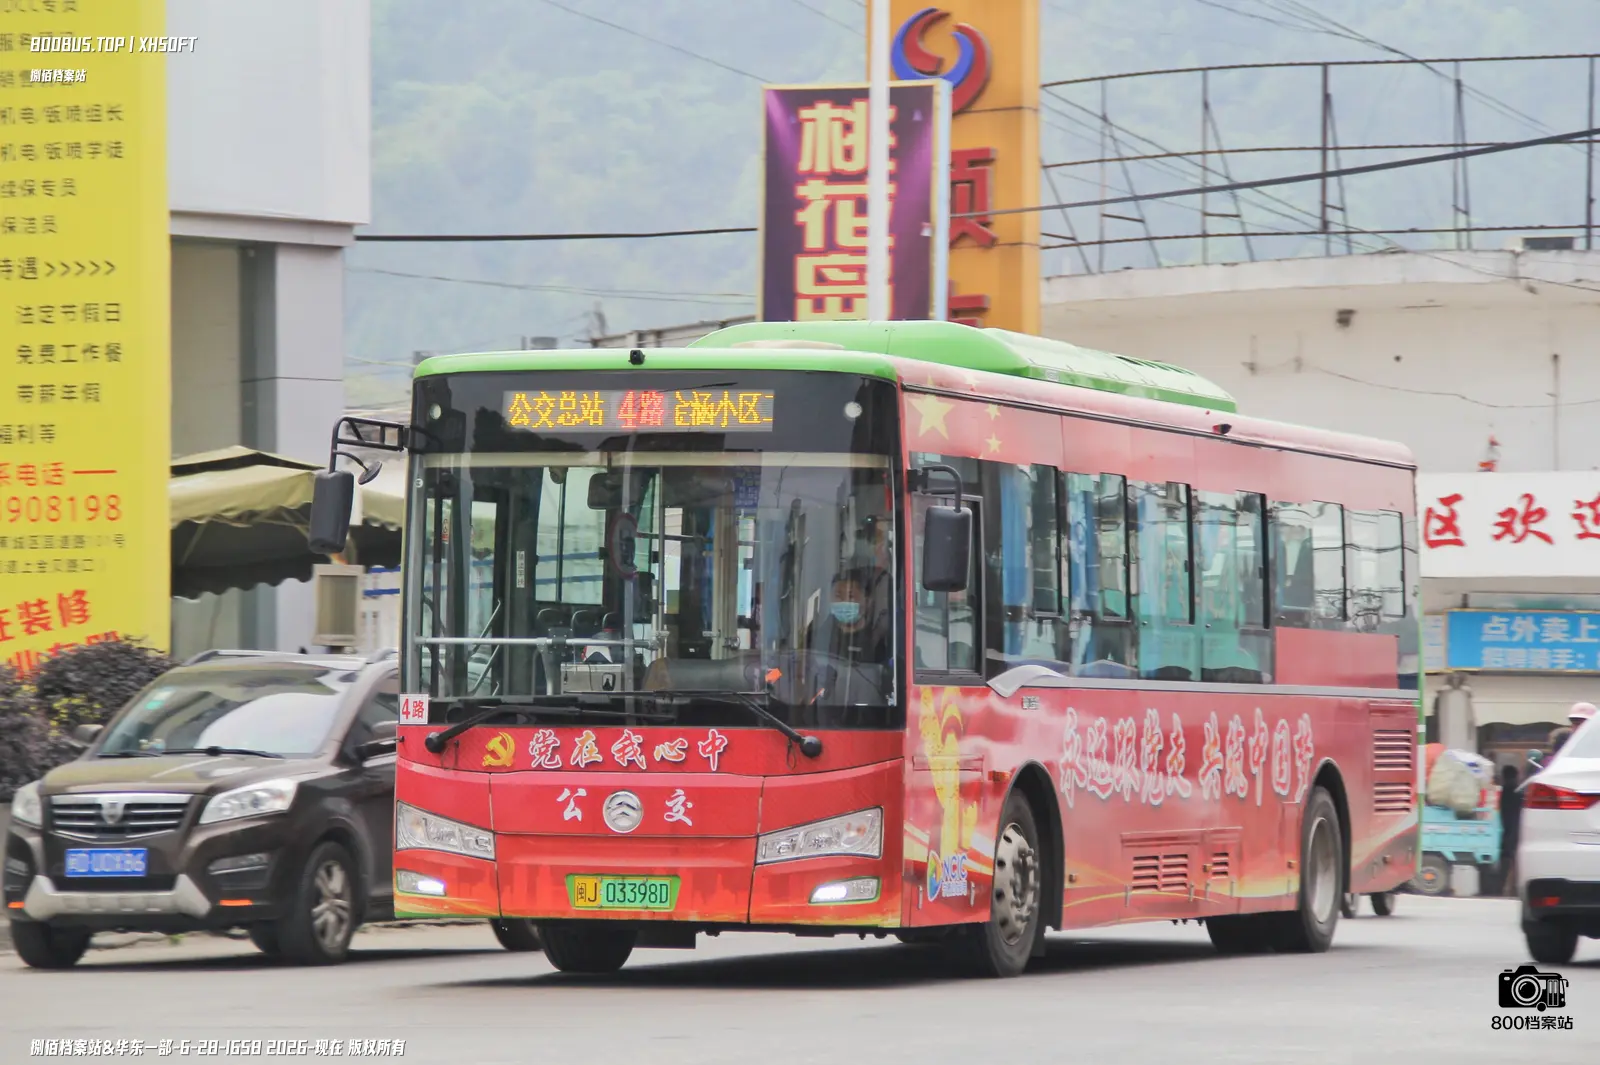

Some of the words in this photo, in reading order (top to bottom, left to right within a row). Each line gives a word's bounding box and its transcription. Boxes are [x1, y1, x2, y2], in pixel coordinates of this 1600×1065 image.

[16, 343, 122, 364] 免费工作餐
[509, 391, 604, 428] 公交总站
[616, 391, 664, 428] 4路
[401, 697, 425, 720] 4路
[528, 728, 728, 772] 党在我心中
